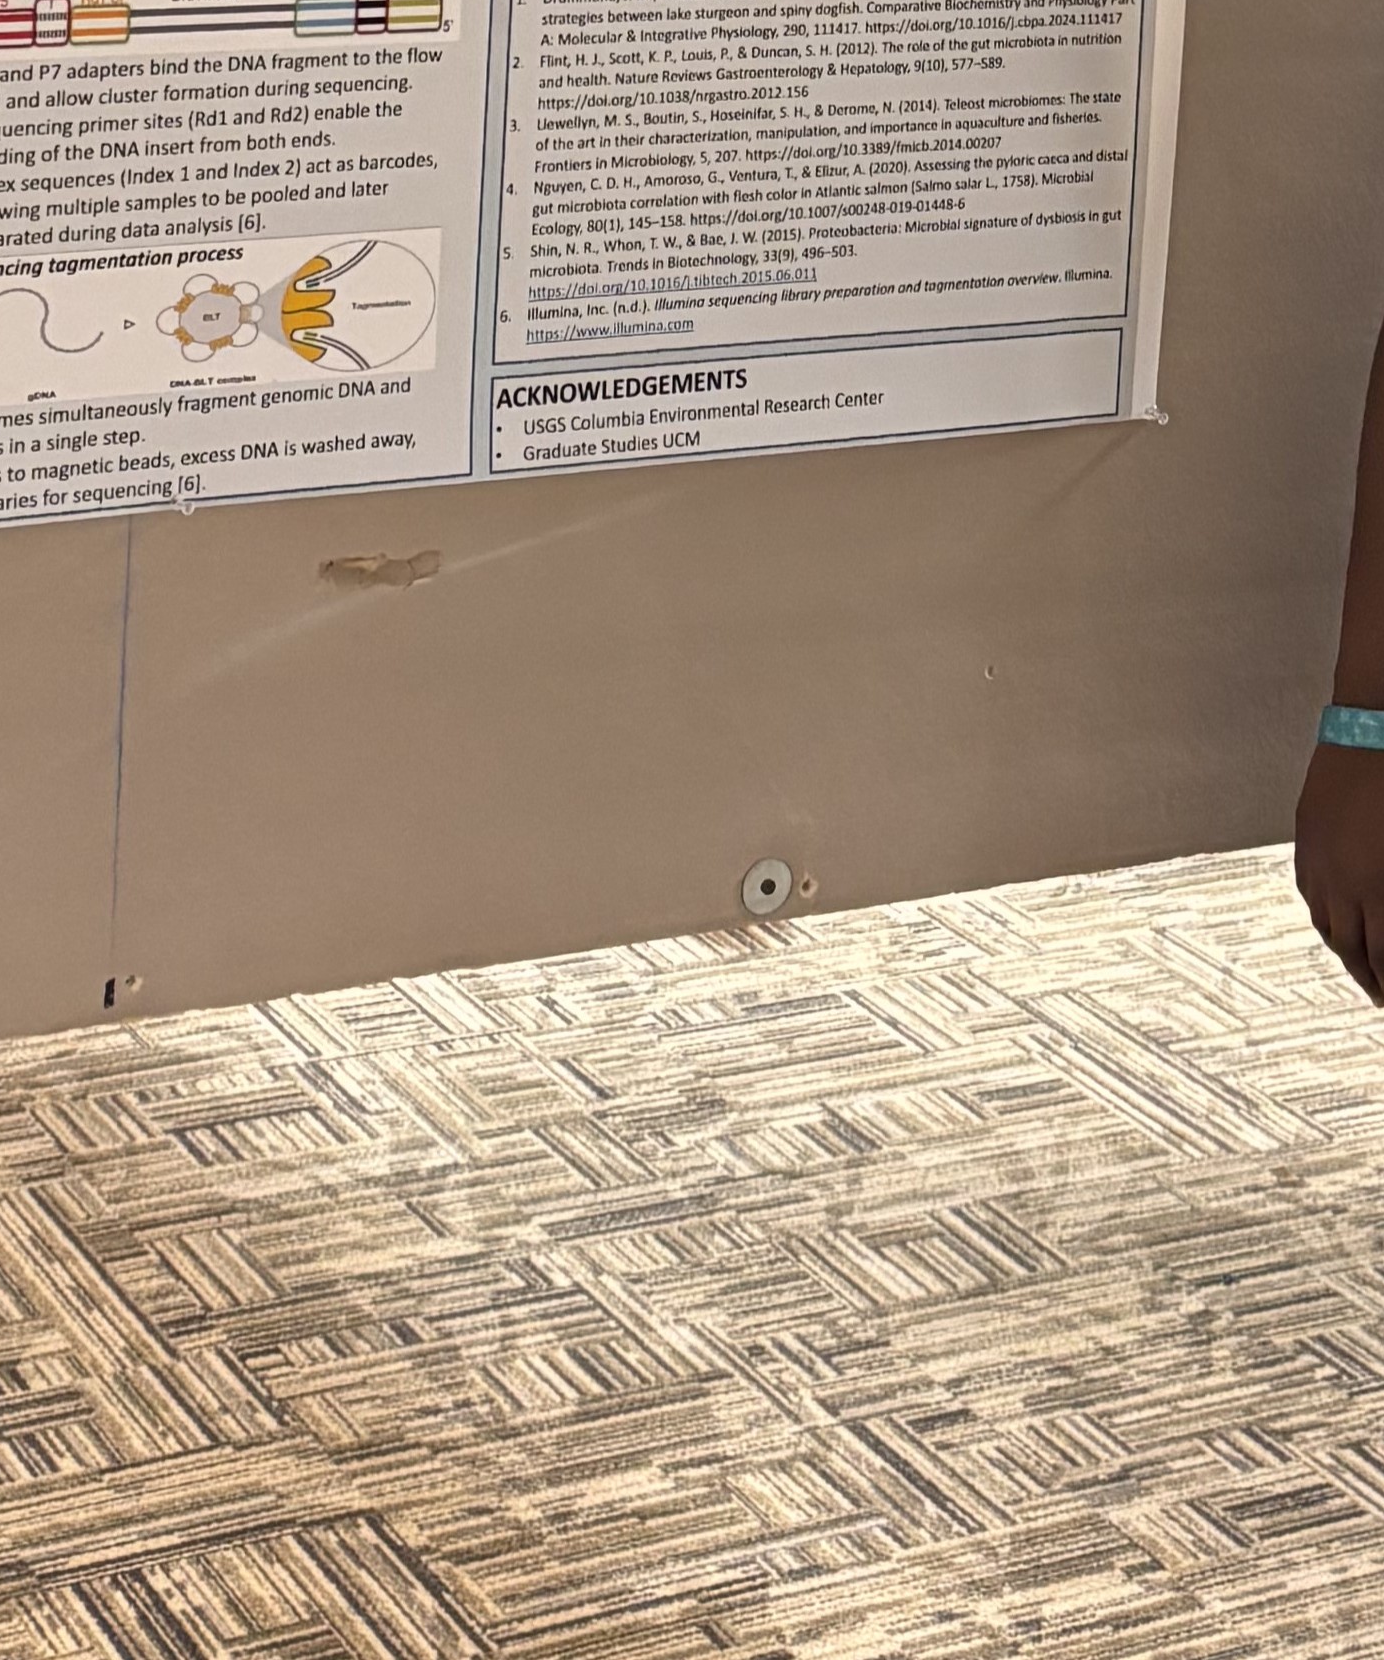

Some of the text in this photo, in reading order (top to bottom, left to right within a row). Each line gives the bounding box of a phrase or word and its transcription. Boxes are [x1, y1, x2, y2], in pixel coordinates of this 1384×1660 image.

[48, 249, 173, 276] tagmentation
[176, 247, 244, 268] process
[526, 317, 695, 344] https://www.illumina.com
[496, 368, 749, 410] ACKNOWLEDGEMENTS
[523, 392, 885, 436] USGS Columbia Environmental Research Center
[523, 430, 701, 461] Graduate Studies UCM
